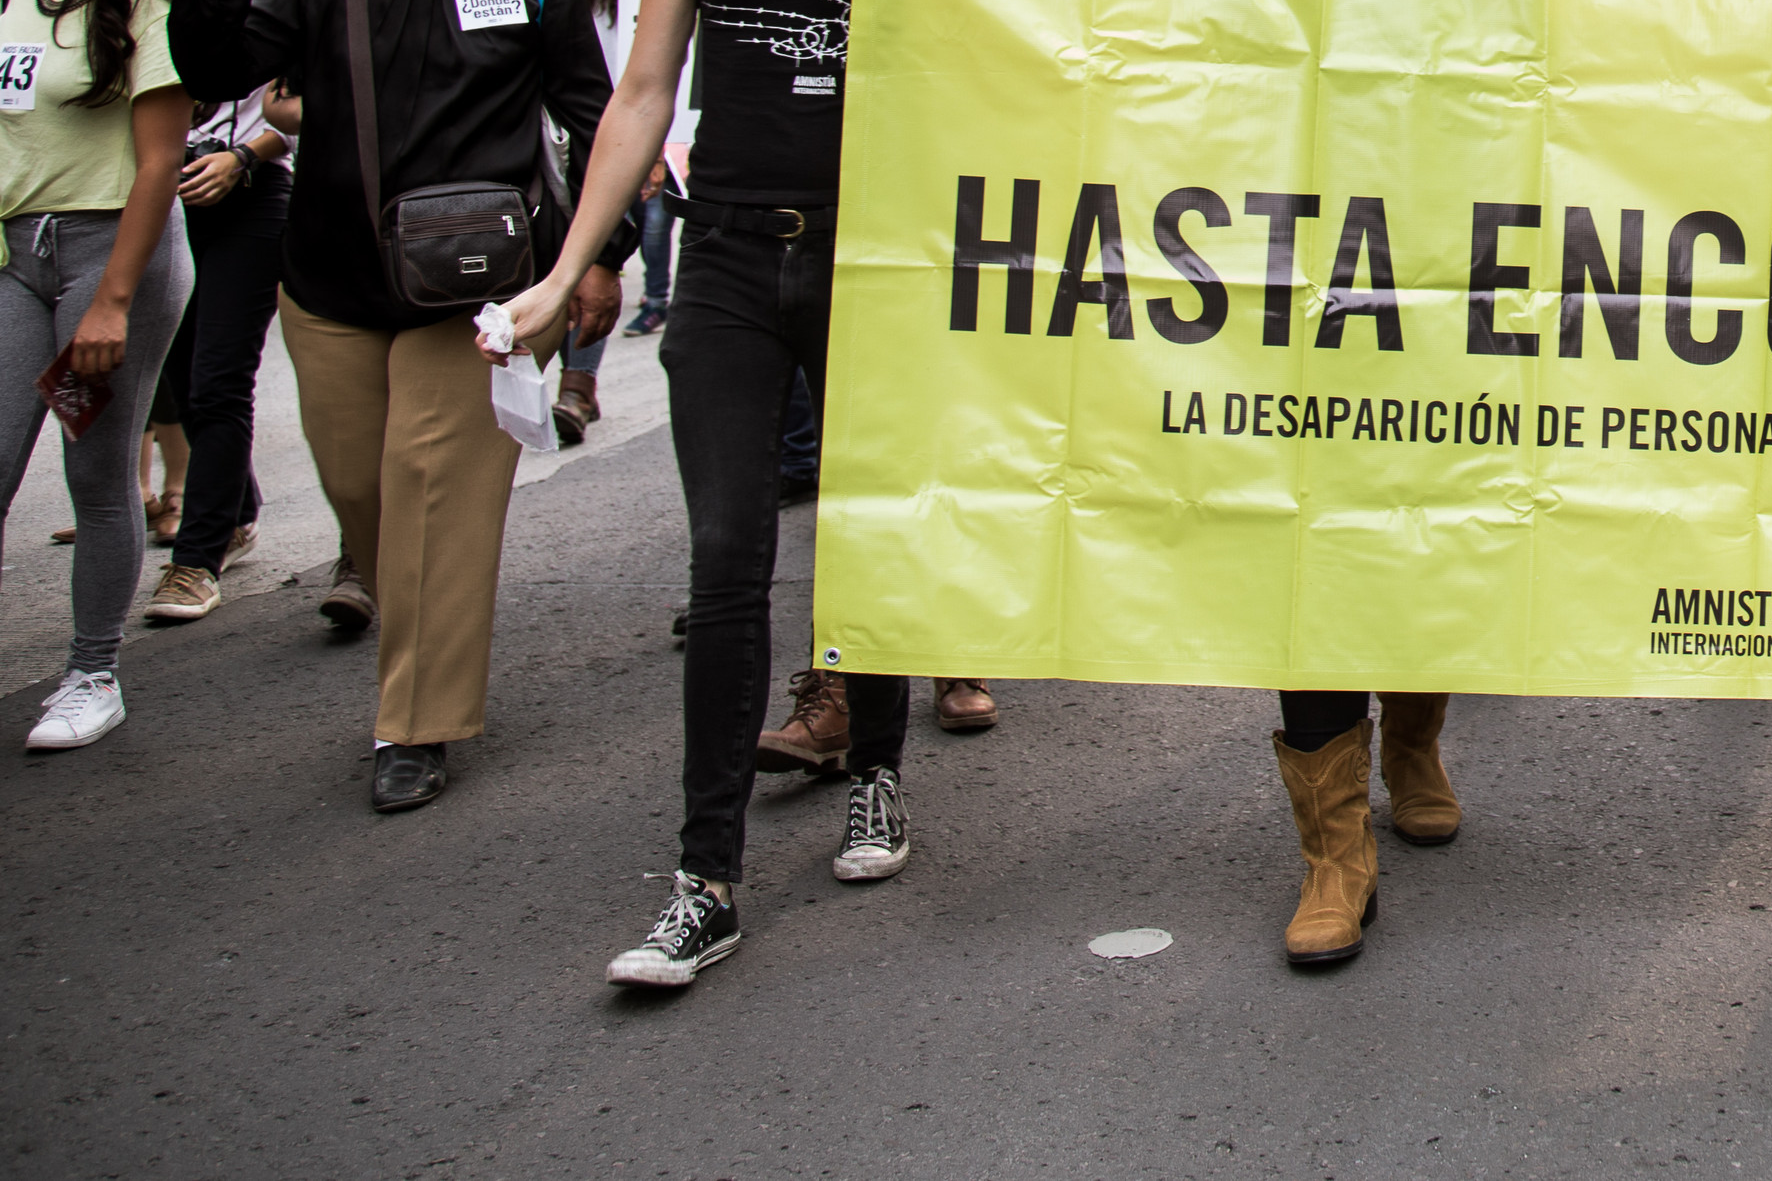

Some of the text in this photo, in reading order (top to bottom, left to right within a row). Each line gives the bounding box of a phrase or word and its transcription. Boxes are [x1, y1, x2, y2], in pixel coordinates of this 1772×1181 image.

[473, 0, 521, 19] están?
[949, 175, 1405, 352] HASTA
[1161, 390, 1207, 435] LA
[1223, 393, 1521, 446] DESAPARICIÓN
[1536, 405, 1585, 448] DE
